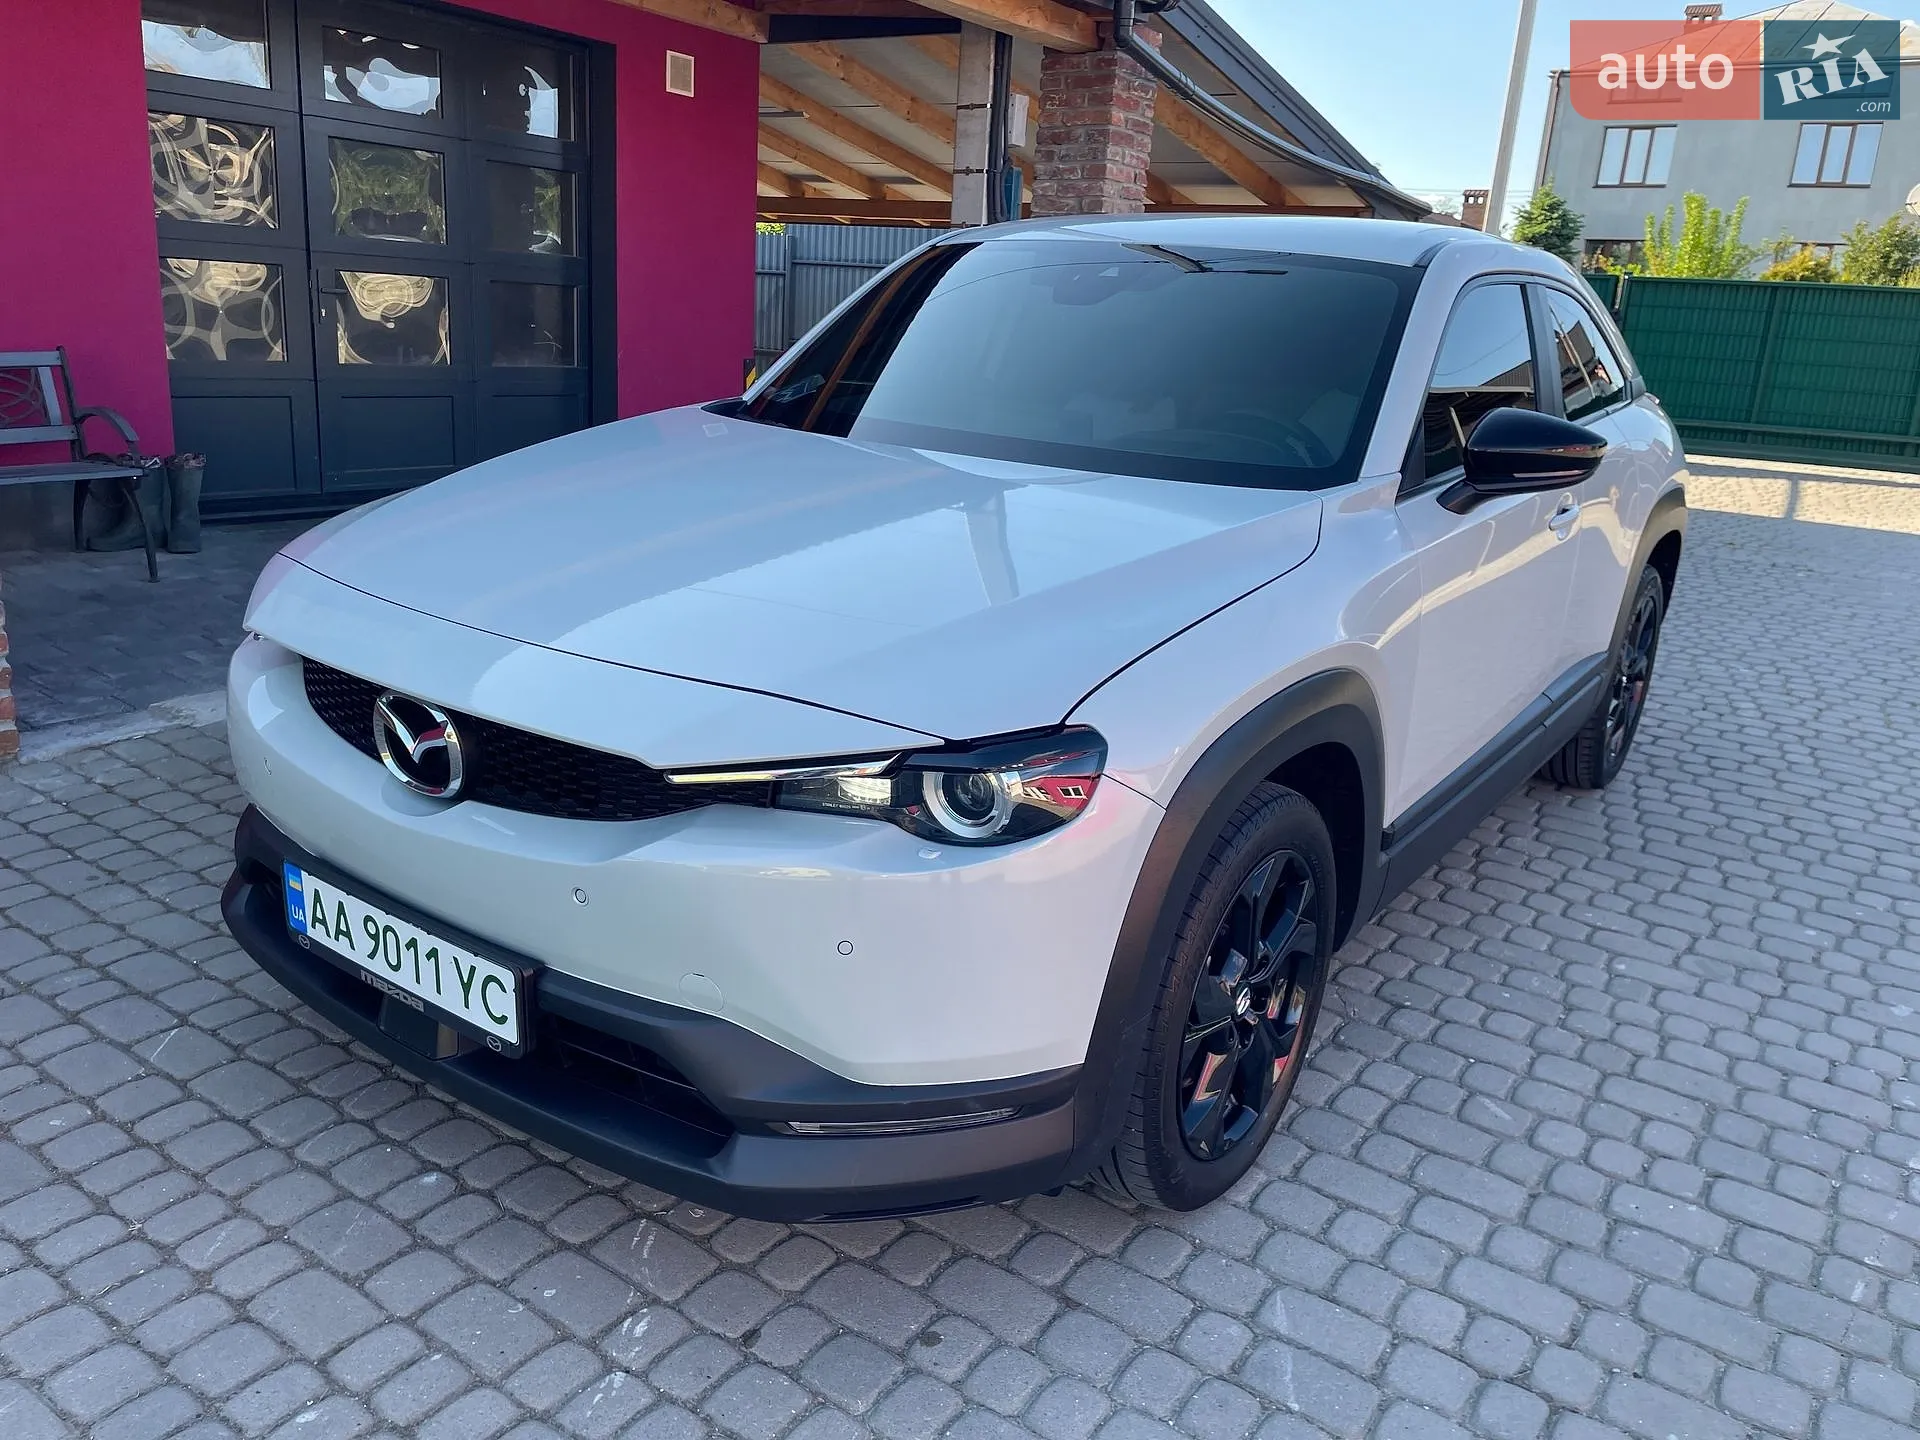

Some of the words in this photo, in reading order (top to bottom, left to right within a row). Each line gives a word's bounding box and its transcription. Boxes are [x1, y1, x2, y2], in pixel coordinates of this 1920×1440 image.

[291, 904, 305, 924] UA
[310, 888, 356, 951] AA
[363, 914, 442, 996] 9011
[452, 955, 508, 1026] YC
